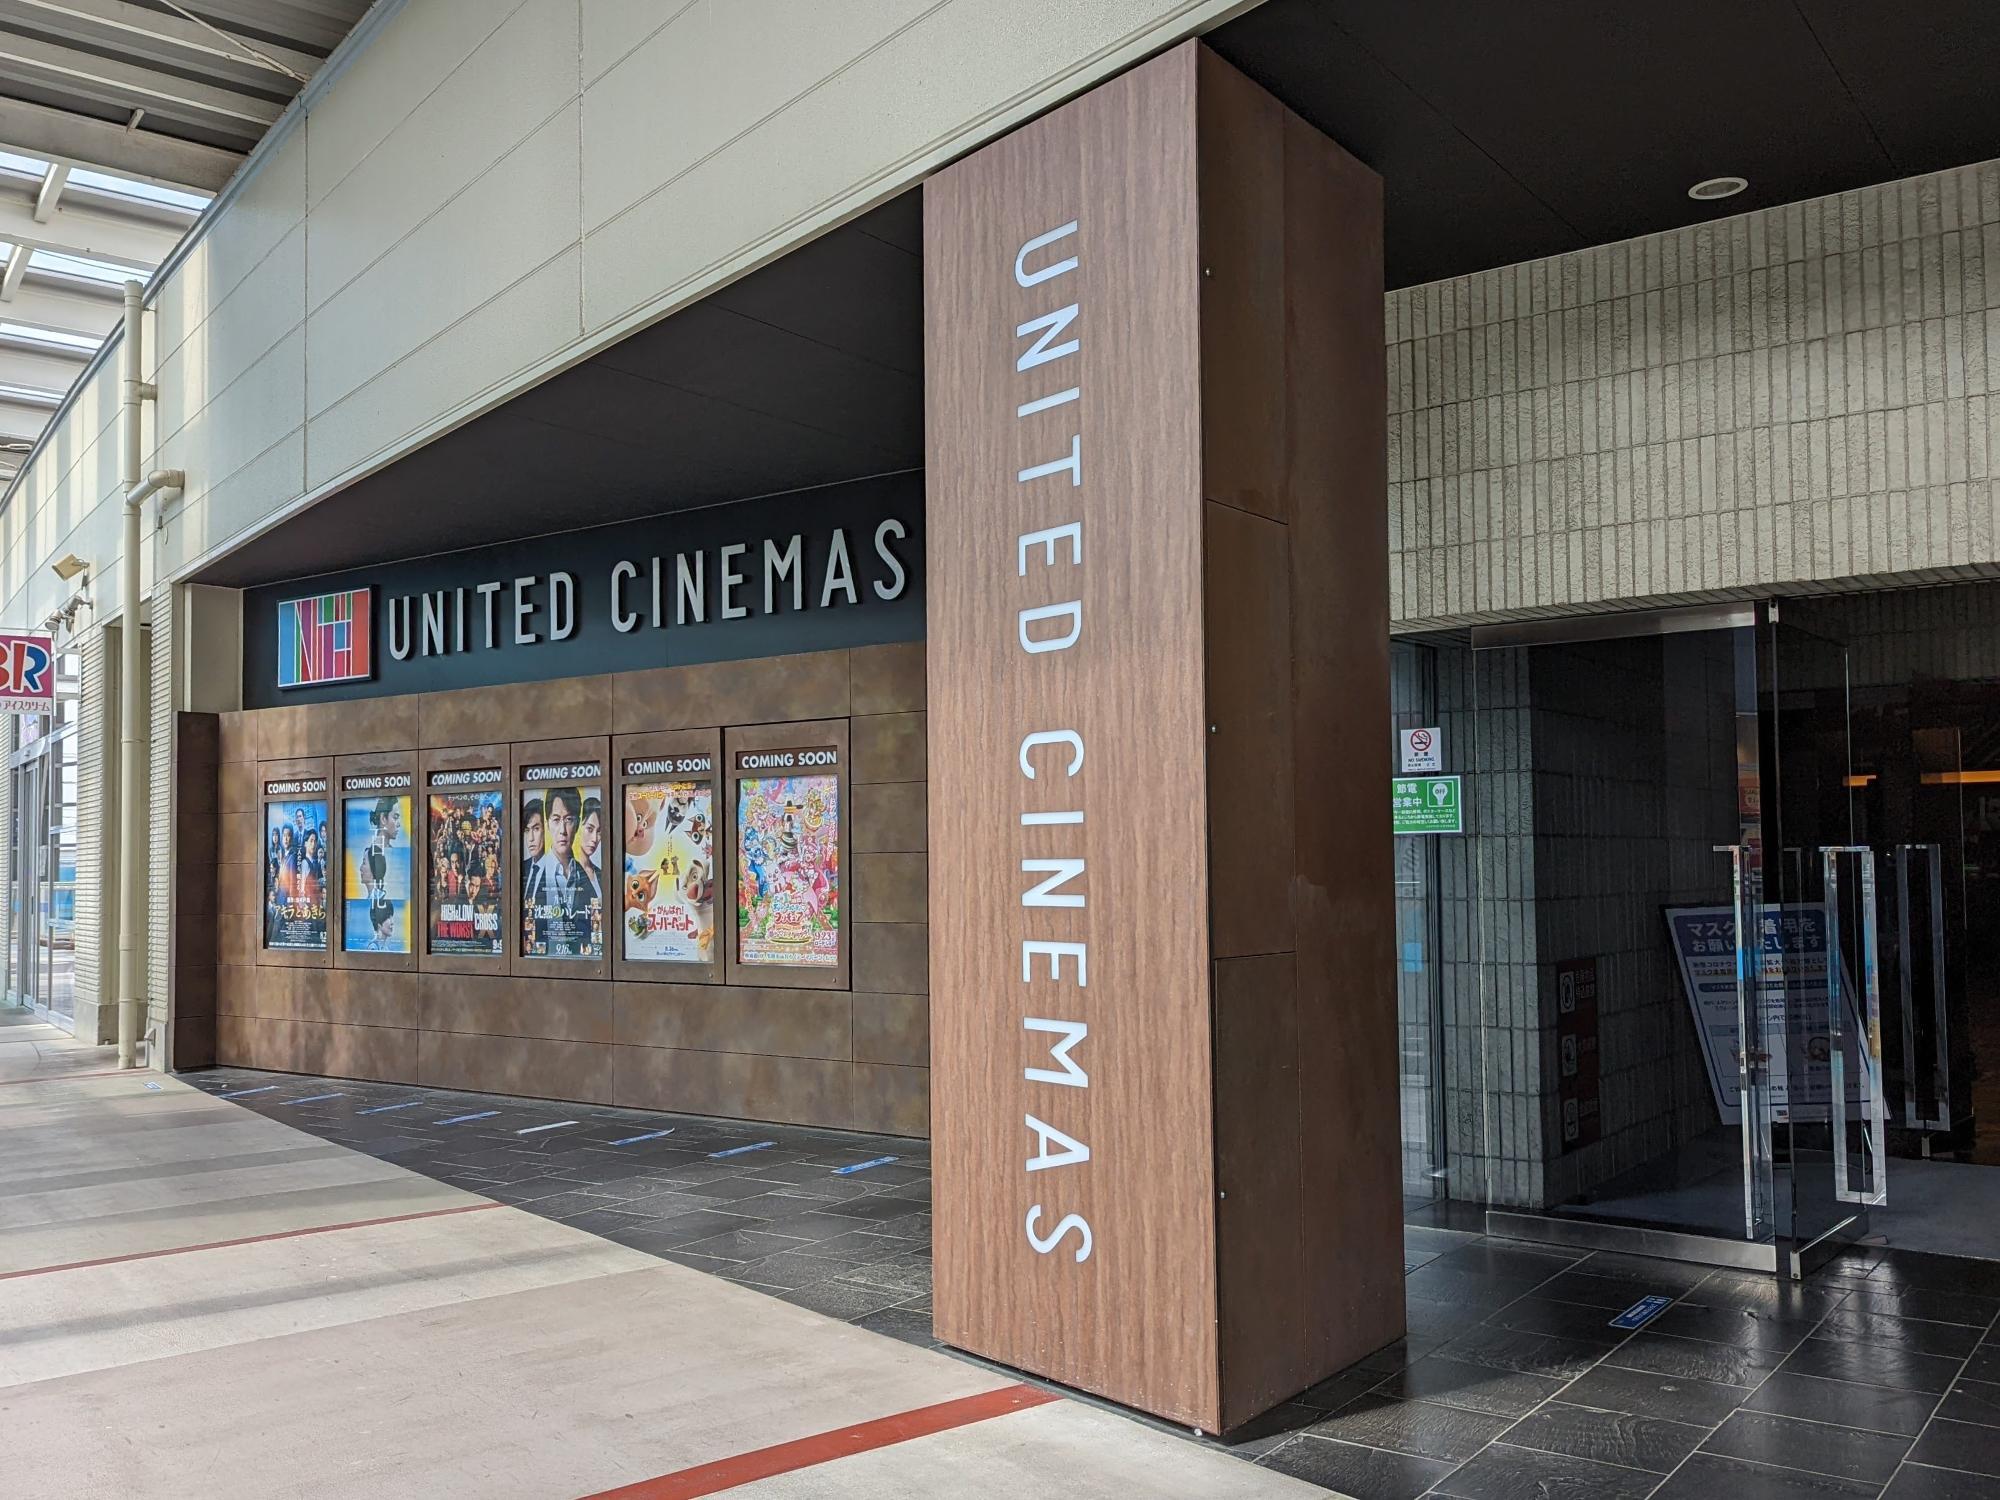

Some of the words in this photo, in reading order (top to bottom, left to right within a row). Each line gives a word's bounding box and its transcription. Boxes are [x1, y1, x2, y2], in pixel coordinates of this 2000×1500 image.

[1014, 219, 1081, 654] UNITED
[389, 571, 574, 661] UNITED
[611, 518, 906, 633] CINEMAS
[628, 760, 673, 775] COMING
[677, 757, 711, 772] SOON
[742, 753, 794, 769] COMING
[798, 750, 837, 765] SOON
[432, 773, 469, 786] COMING
[472, 771, 502, 784] SOON
[526, 767, 568, 780] COMING
[571, 764, 601, 779] SOON
[267, 782, 300, 794] COMING
[302, 780, 326, 792] SOON
[346, 777, 381, 789] COMING
[384, 775, 411, 788] SOON
[1396, 783, 1418, 794] 節電
[475, 913, 498, 930] CROSS
[647, 913, 695, 931] スーパーペット
[1019, 729, 1093, 1263] CINEMAS
